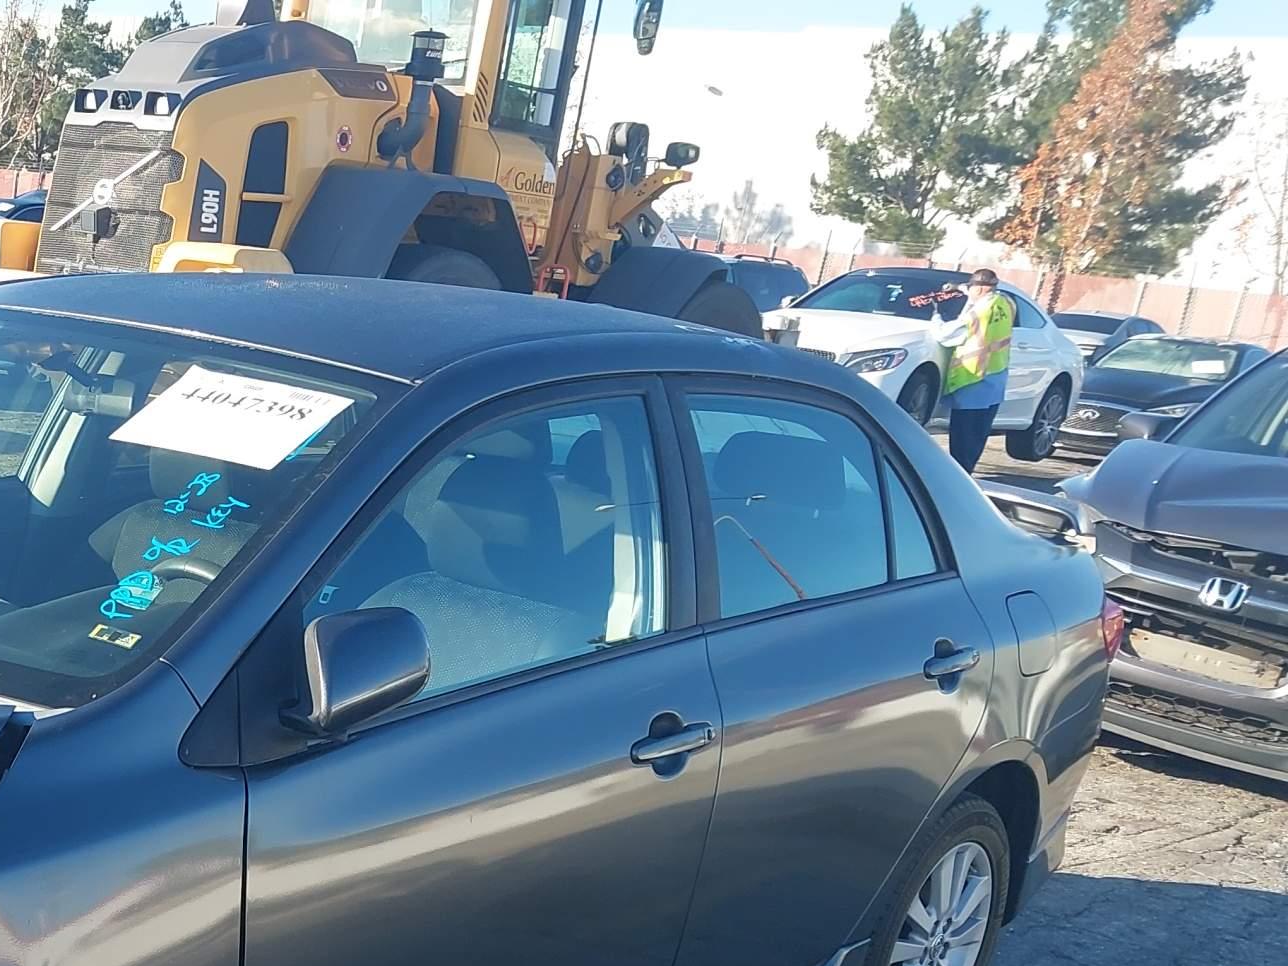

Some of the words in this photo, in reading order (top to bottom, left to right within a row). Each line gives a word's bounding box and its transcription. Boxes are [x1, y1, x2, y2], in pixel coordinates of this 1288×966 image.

[514, 172, 555, 194] Golden
[199, 189, 221, 234] L90H
[181, 387, 314, 422] 44047398
